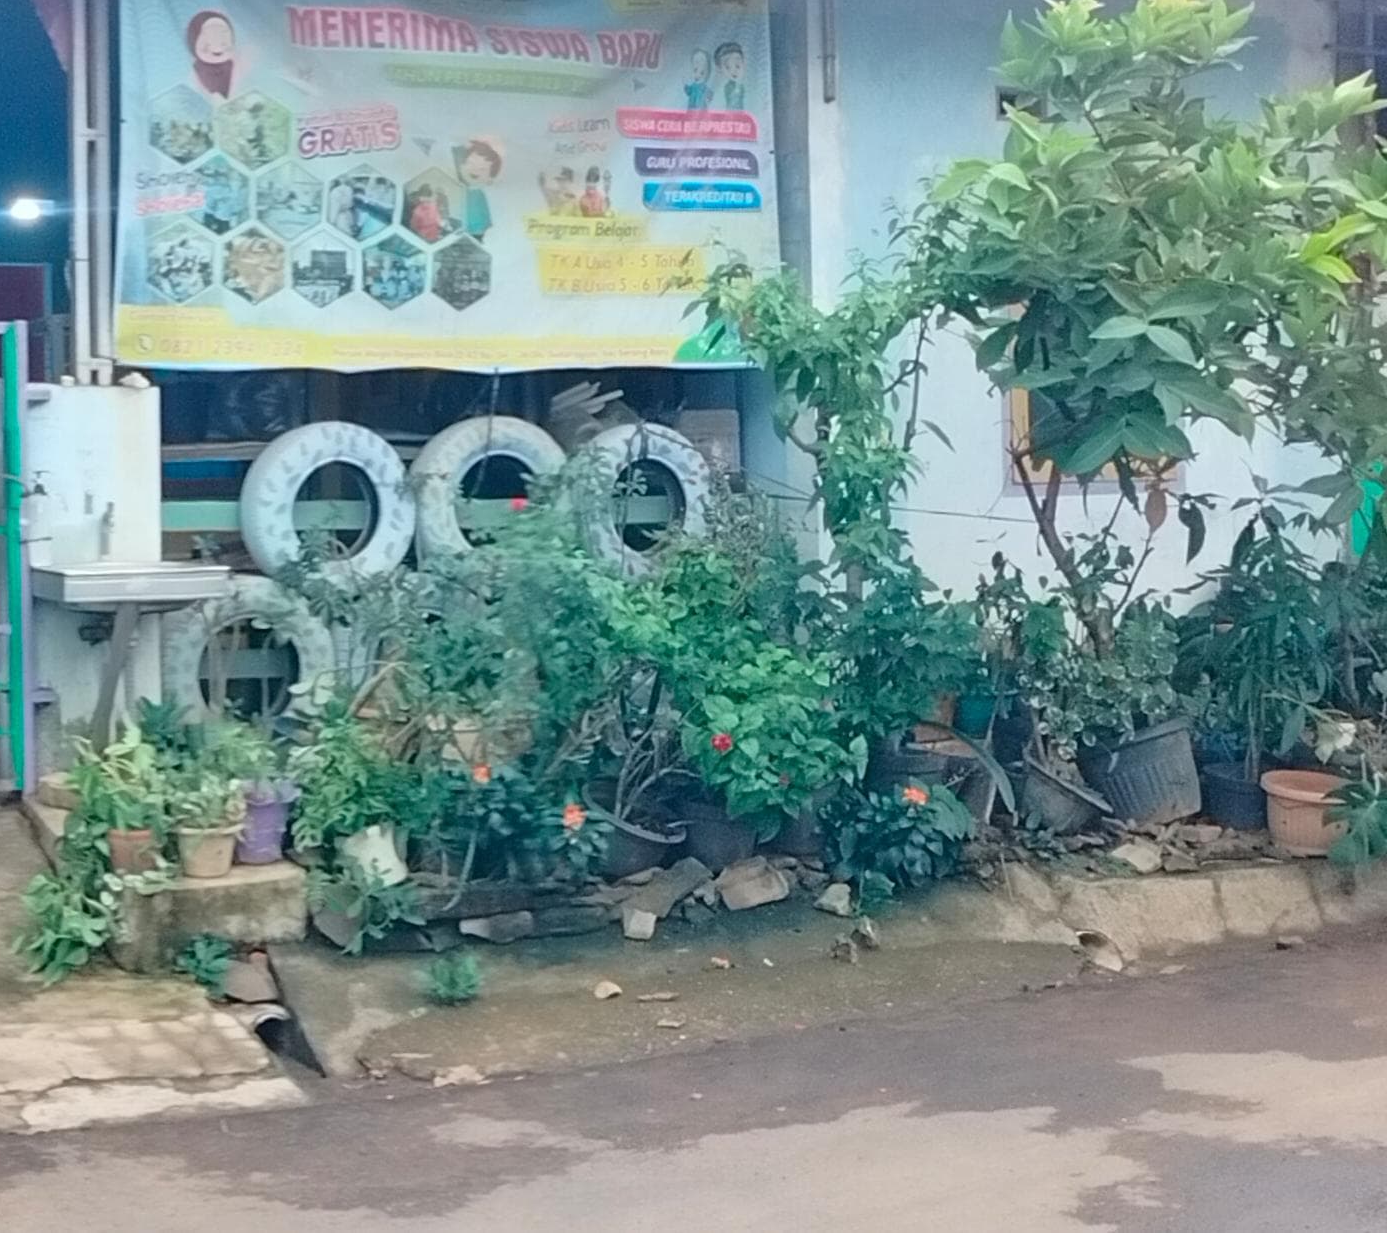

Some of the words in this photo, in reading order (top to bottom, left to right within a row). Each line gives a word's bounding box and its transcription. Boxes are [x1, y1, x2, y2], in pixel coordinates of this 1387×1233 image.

[287, 7, 478, 52] MENERIMA
[485, 25, 590, 63] SISWA
[597, 32, 664, 69] BARU
[298, 122, 397, 154] GRATIS
[528, 219, 590, 240] Program
